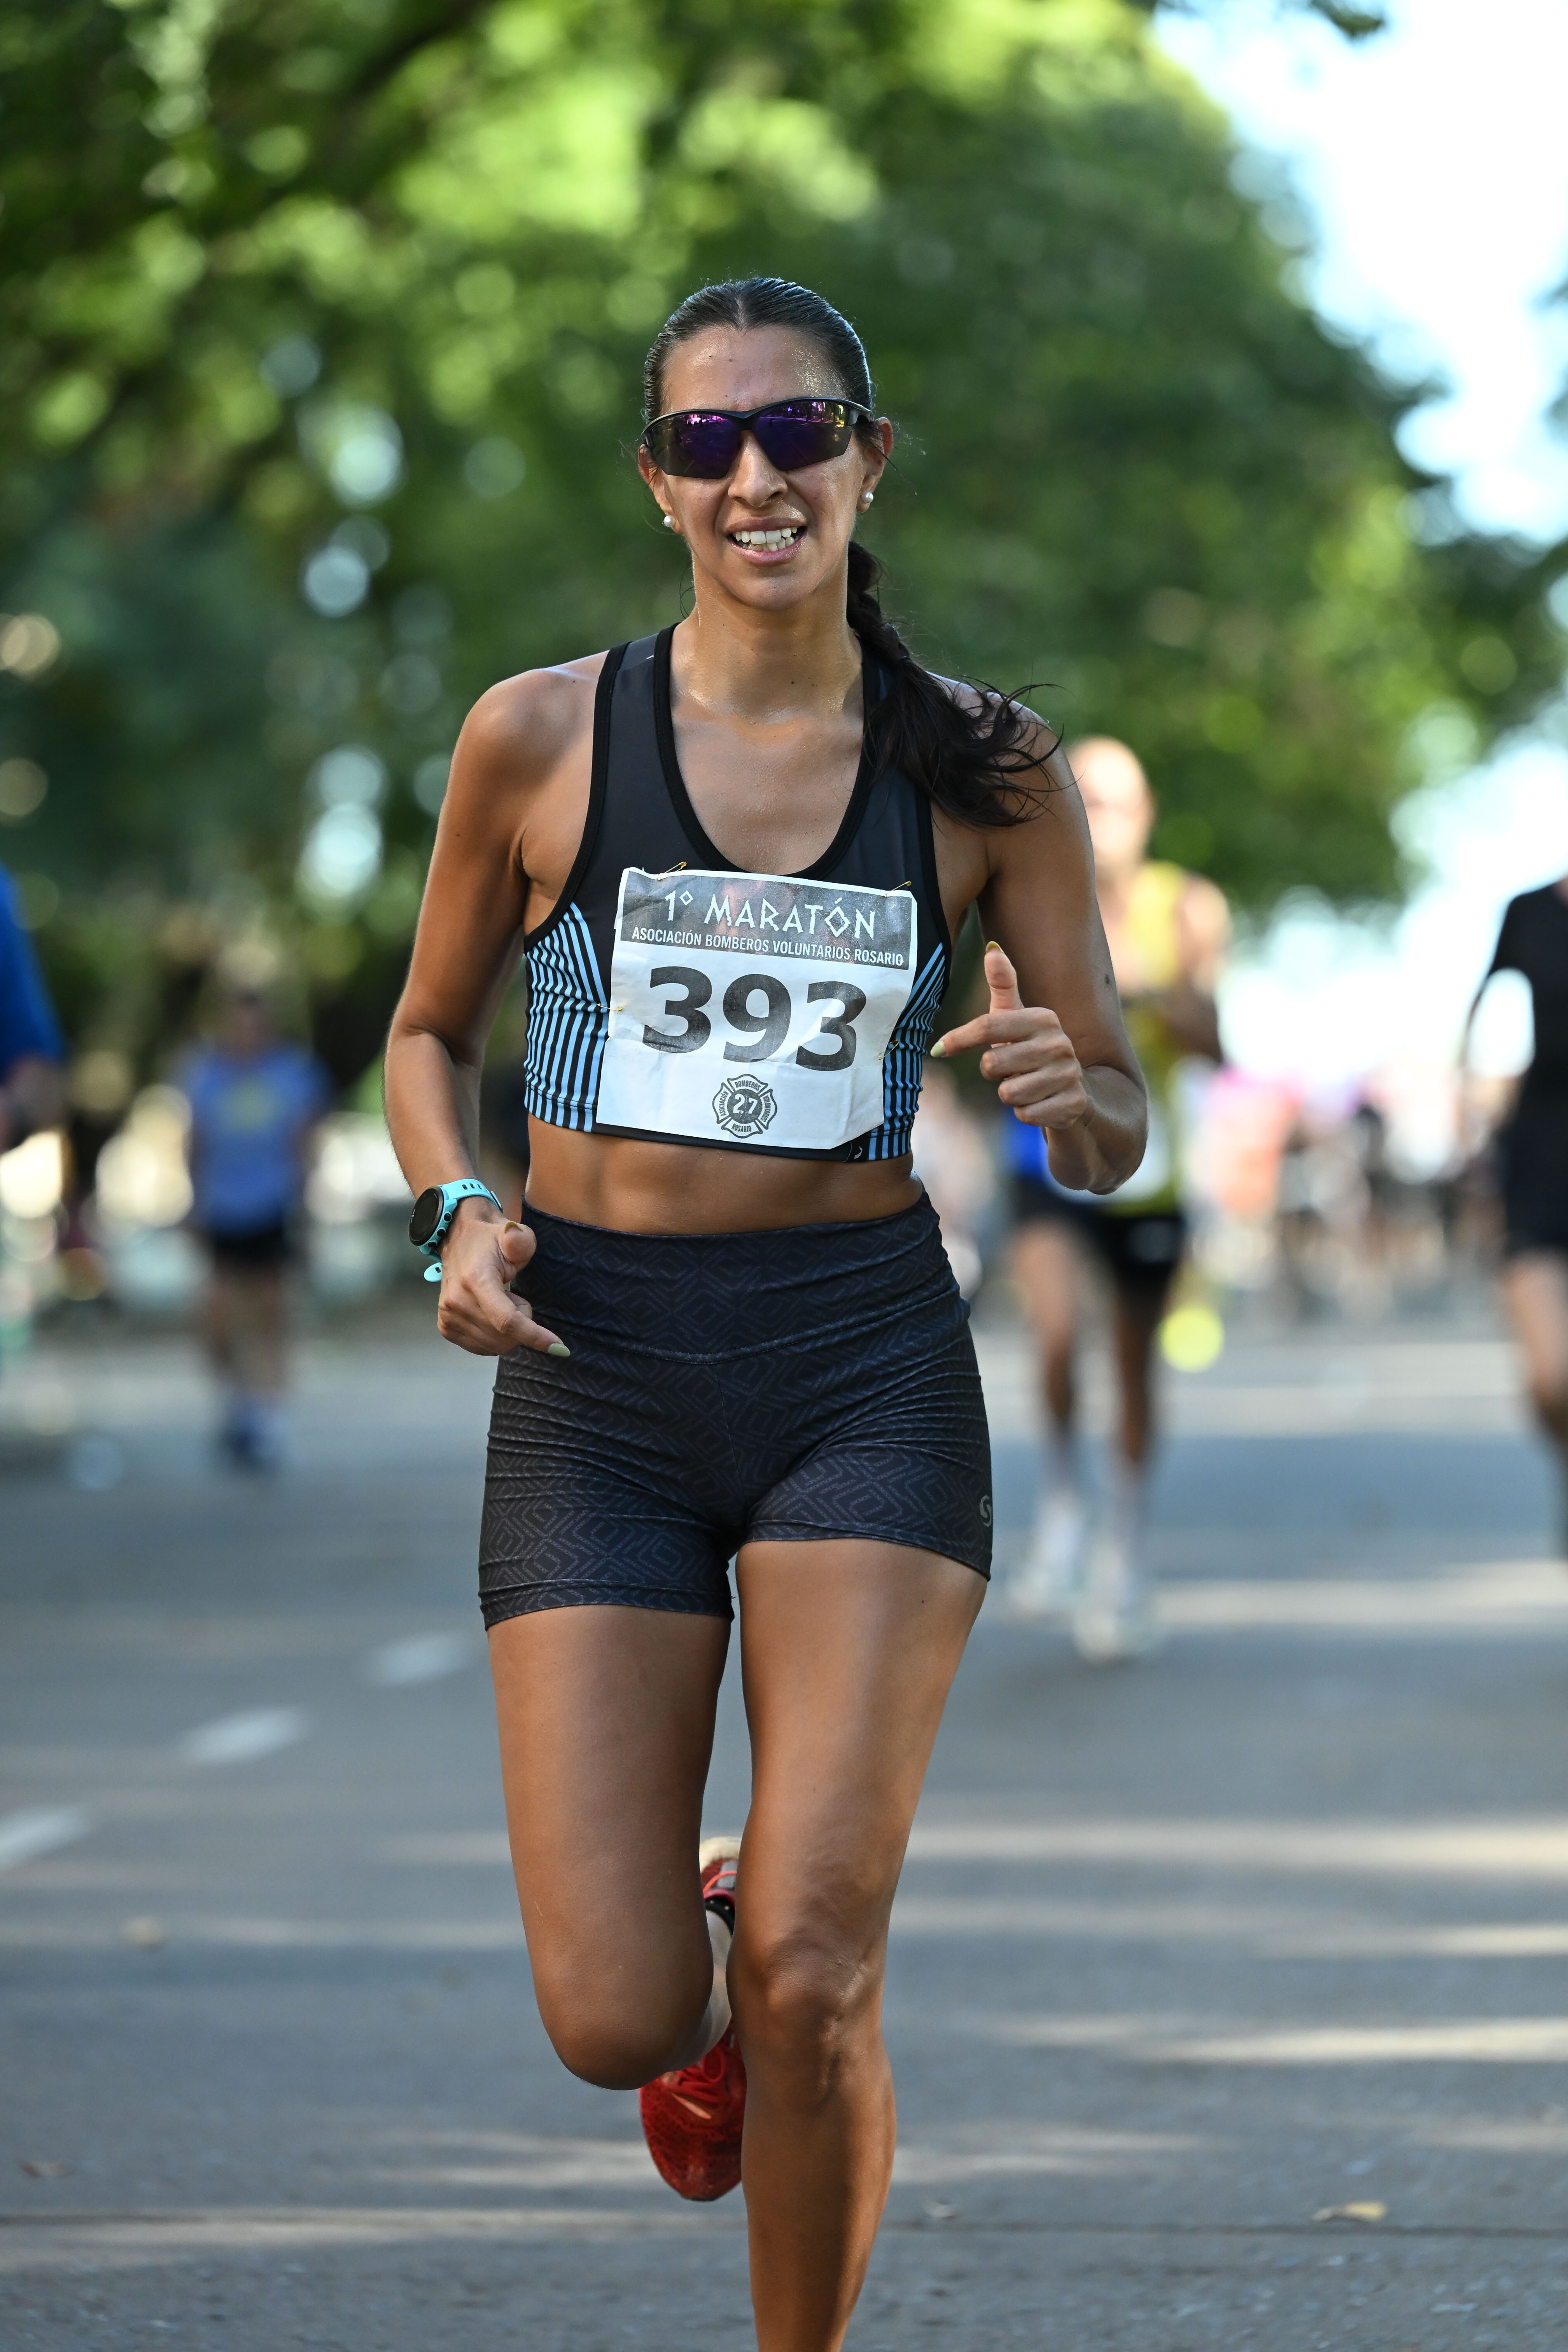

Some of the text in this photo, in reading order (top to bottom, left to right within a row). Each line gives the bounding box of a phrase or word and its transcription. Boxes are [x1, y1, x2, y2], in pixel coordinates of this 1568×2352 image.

[703, 894, 875, 941] MARATÓN
[632, 927, 904, 966] ASOCIACIÓN BOMBEROS VOLUNTARIOS ROSARIO
[642, 966, 868, 1072] 393
[735, 1080, 761, 1091] BOMBEROS
[718, 1090, 729, 1116] ASOCIACIÓN
[733, 1093, 758, 1114] 27
[732, 1123, 752, 1132] ROSARIO
